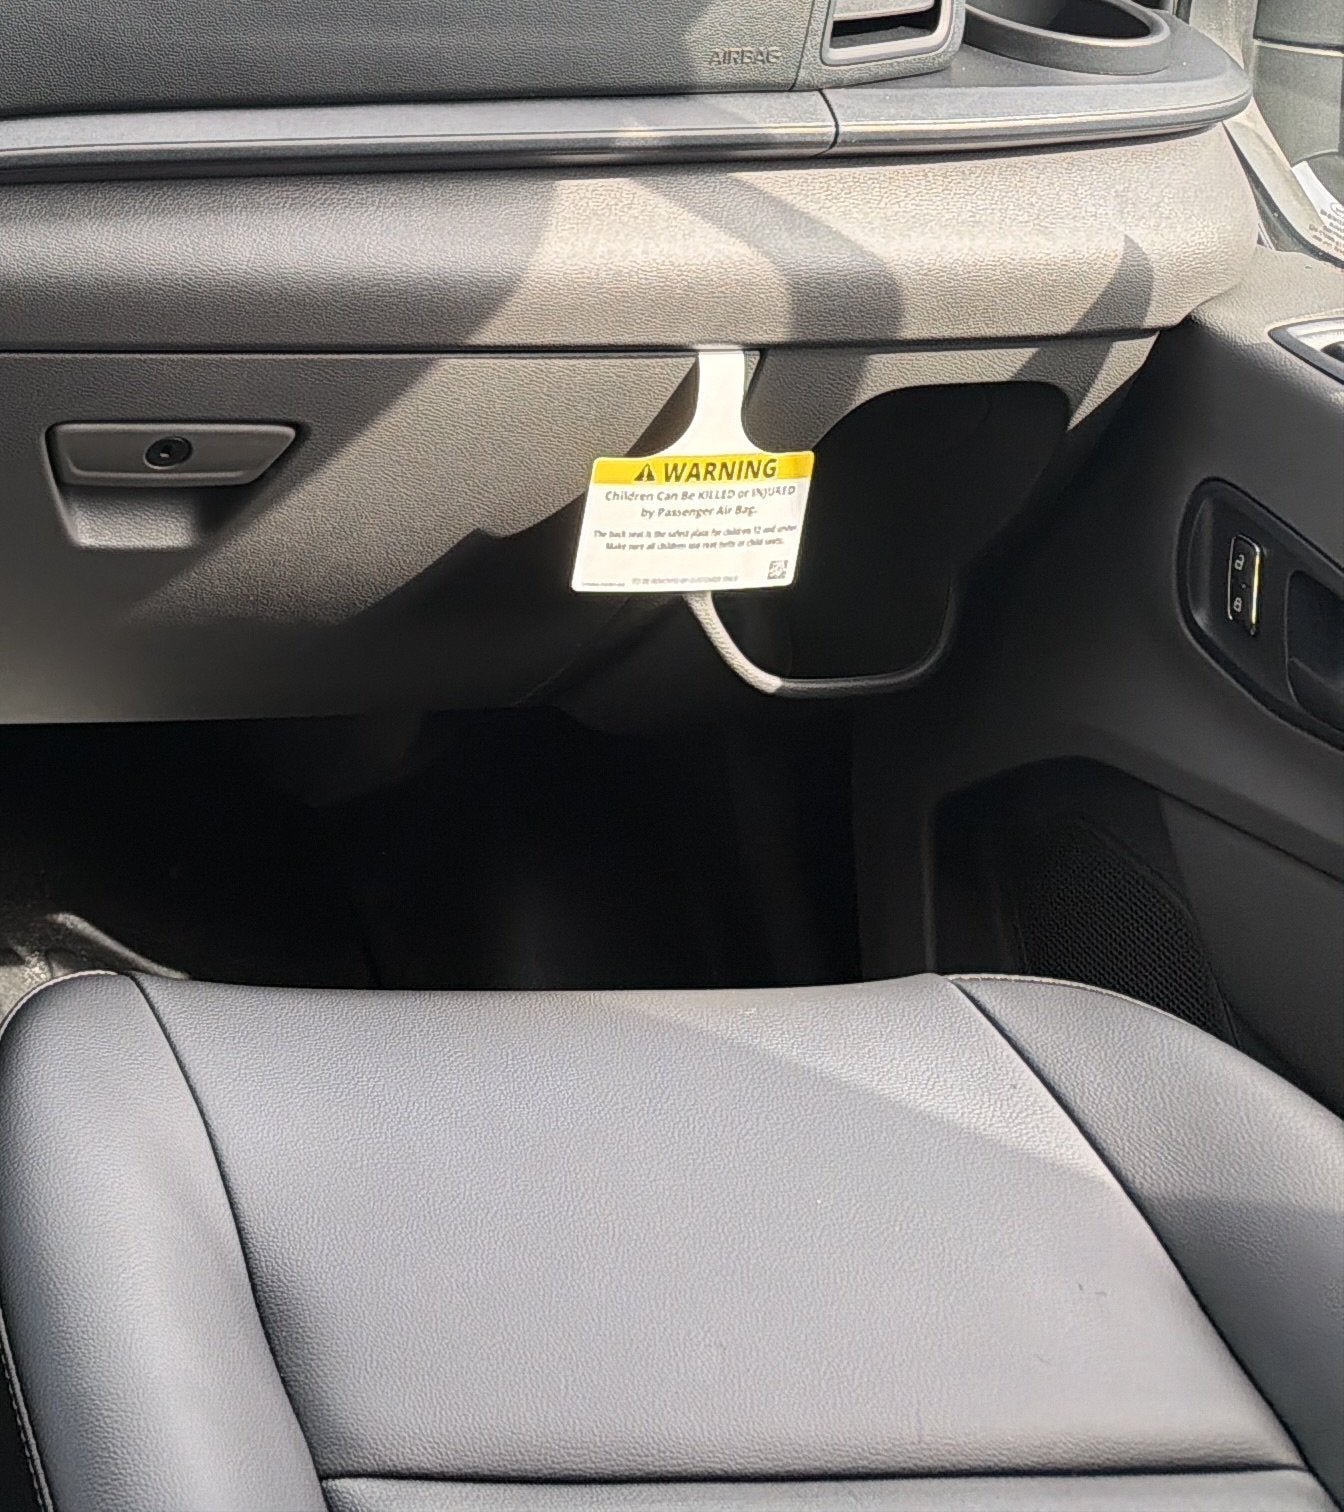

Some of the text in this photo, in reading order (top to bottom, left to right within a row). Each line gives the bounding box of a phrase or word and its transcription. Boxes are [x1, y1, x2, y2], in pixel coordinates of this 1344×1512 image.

[709, 48, 782, 66] AIRBAG
[663, 458, 778, 483] WARNING
[605, 485, 796, 502] Children Can Be KILLED or INJURED
[640, 506, 655, 519] by
[657, 506, 713, 519] Passenger
[716, 505, 733, 516] Air
